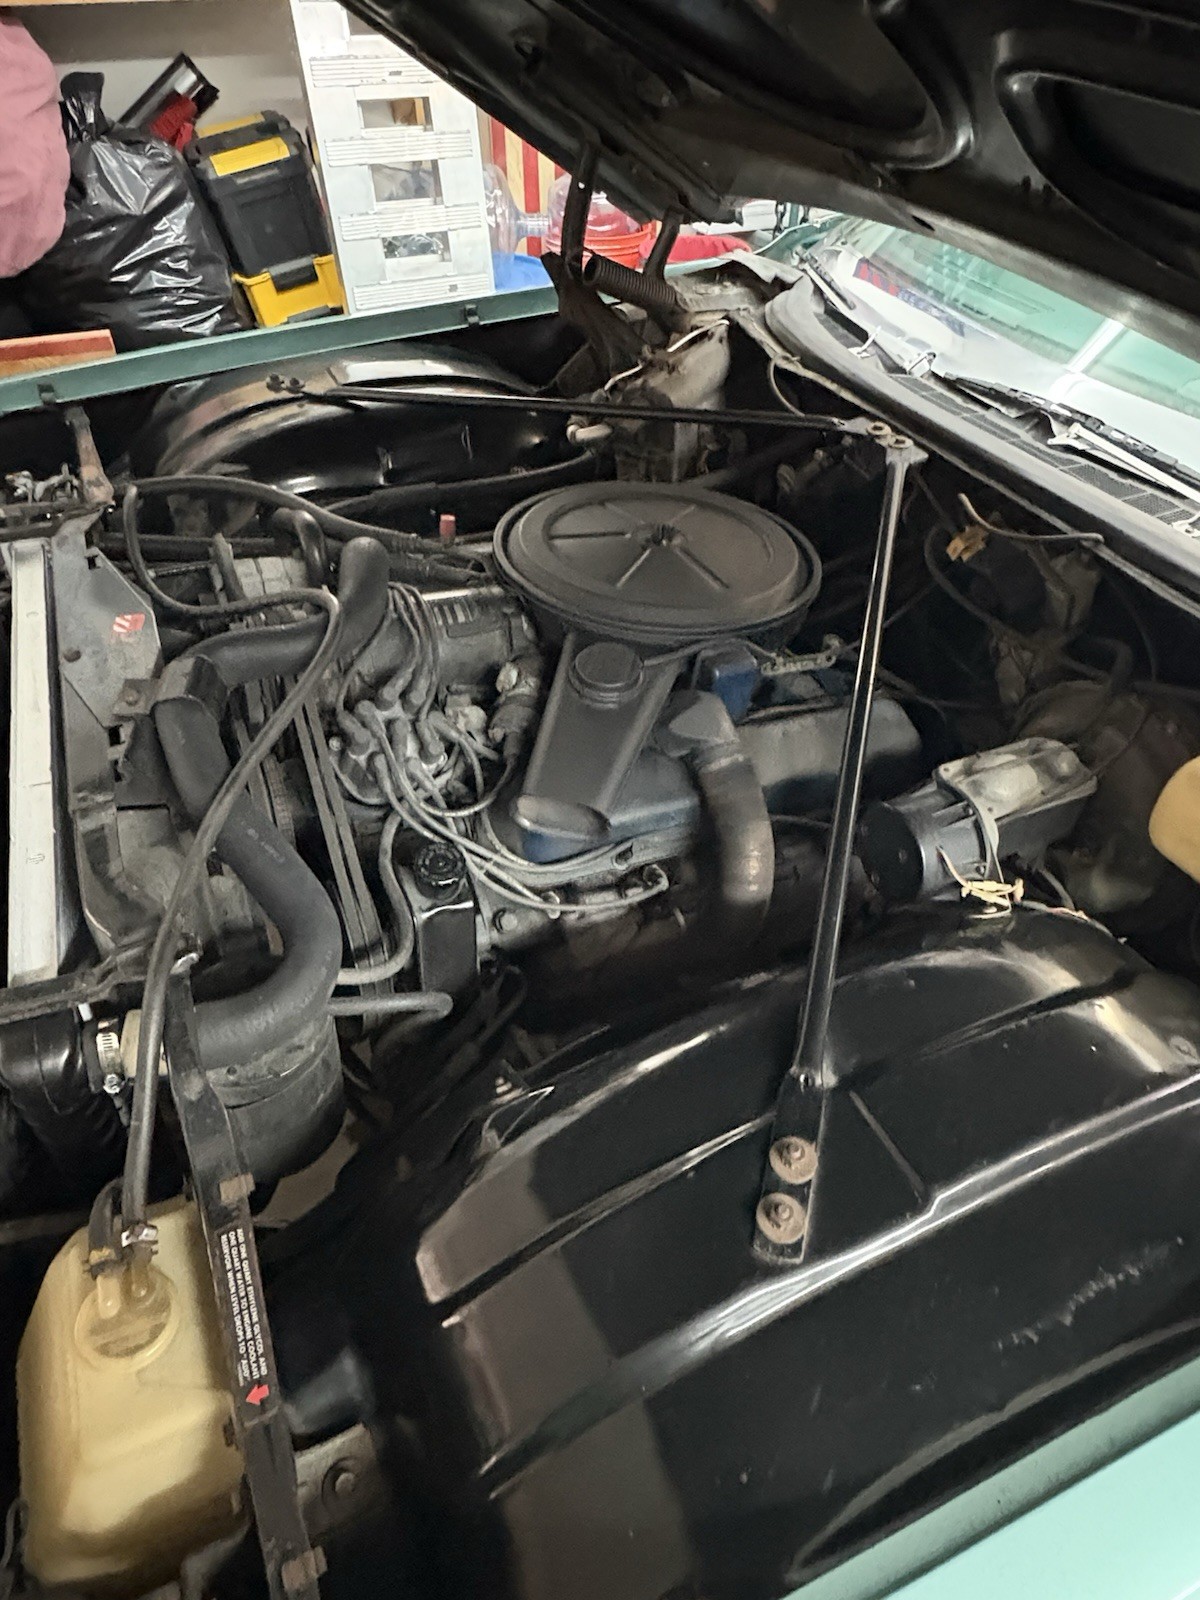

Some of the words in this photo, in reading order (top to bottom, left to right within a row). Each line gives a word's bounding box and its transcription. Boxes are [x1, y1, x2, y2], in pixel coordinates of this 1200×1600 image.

[221, 1234, 232, 1270] RESERVOIR
[231, 1247, 241, 1271] QUART
[239, 1243, 247, 1259] ONE
[227, 1270, 236, 1293] WHEN
[236, 1271, 245, 1297] WATER
[242, 1260, 252, 1285] QUART
[231, 1294, 240, 1315] LEVEL
[241, 1297, 247, 1309] TO
[247, 1286, 258, 1323] ETHYLENE
[234, 1315, 244, 1342] DROPS
[242, 1310, 253, 1340] ENGINE
[239, 1341, 246, 1354] TO
[254, 1324, 264, 1356] GLYCOL
[247, 1341, 260, 1379] COOLANT
[259, 1357, 268, 1375] AND
